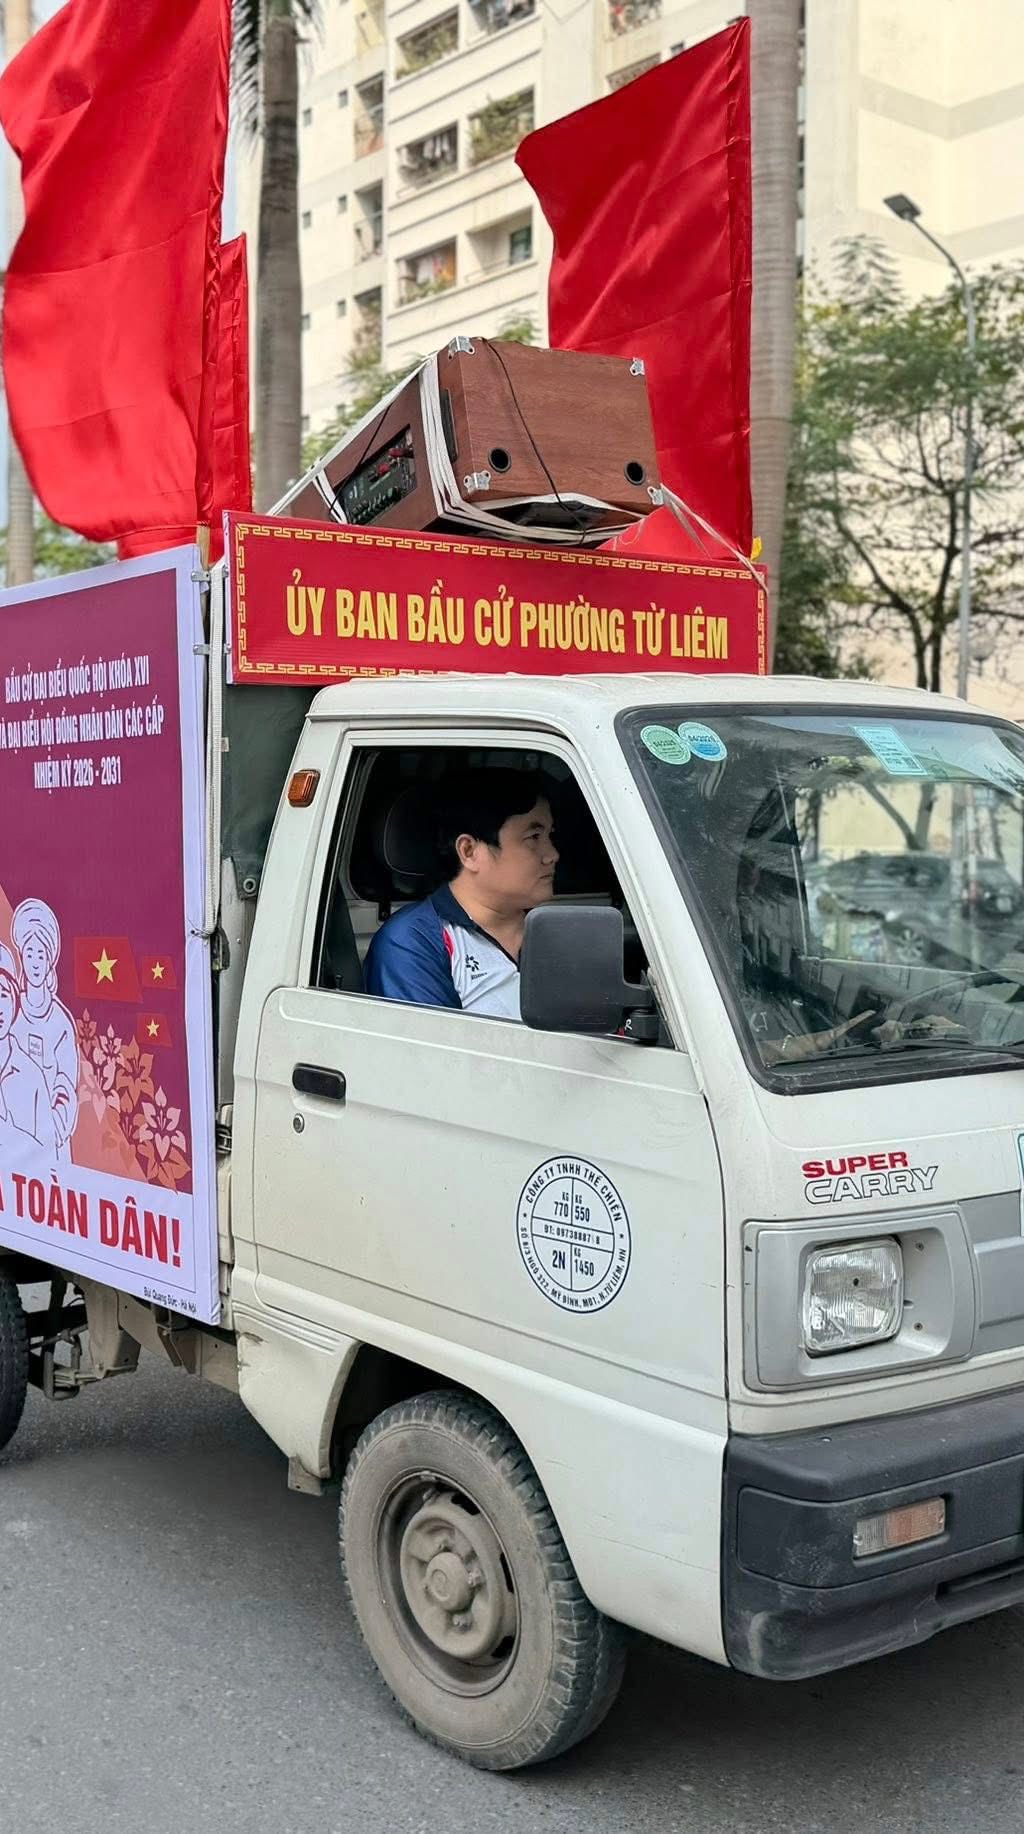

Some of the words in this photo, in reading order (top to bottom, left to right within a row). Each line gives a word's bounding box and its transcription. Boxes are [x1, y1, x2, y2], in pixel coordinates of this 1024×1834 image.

[286, 569, 324, 636] ỦY
[337, 590, 398, 641] BAN
[408, 578, 465, 644] BẦU
[474, 583, 514, 647] CỬ
[521, 596, 624, 654] PHƯỜNG
[632, 601, 664, 656] TỪ
[670, 608, 728, 660] LIÊM
[21, 662, 33, 701] CỬ
[33, 672, 47, 705] ĐẠI
[48, 658, 66, 698] BIỂU
[68, 655, 90, 698] QUỐC
[92, 656, 106, 697] HỘI
[109, 652, 133, 690] KHÓA
[134, 655, 150, 686] XVI
[8, 721, 20, 754] ĐẠI
[22, 708, 39, 747] BIỂU
[41, 712, 55, 751] HỘI
[55, 707, 77, 744] ĐỒNG
[79, 707, 104, 742] NHÂN
[105, 704, 123, 740] DÂN
[125, 701, 143, 737] CÁC
[145, 695, 164, 736] CẤP
[34, 755, 60, 794] NHIỆM
[61, 753, 72, 787] KỲ
[73, 758, 93, 786] 2026
[101, 755, 121, 785] 2031
[525, 1175, 545, 1204] CÔNG
[544, 1166, 554, 1179] TY
[557, 1163, 581, 1175] TNHH
[802, 1151, 909, 1179] SUPER
[804, 1165, 938, 1205] CARRY
[12, 1168, 88, 1238] TOÀN
[99, 1196, 182, 1268] DÂN!
[554, 1201, 569, 1218] 770
[575, 1205, 590, 1223] 550
[562, 1192, 569, 1202] KG
[575, 1194, 582, 1205] KG
[552, 1249, 566, 1270] 2N
[574, 1259, 594, 1277] 1450
[574, 1247, 581, 1258] KG
